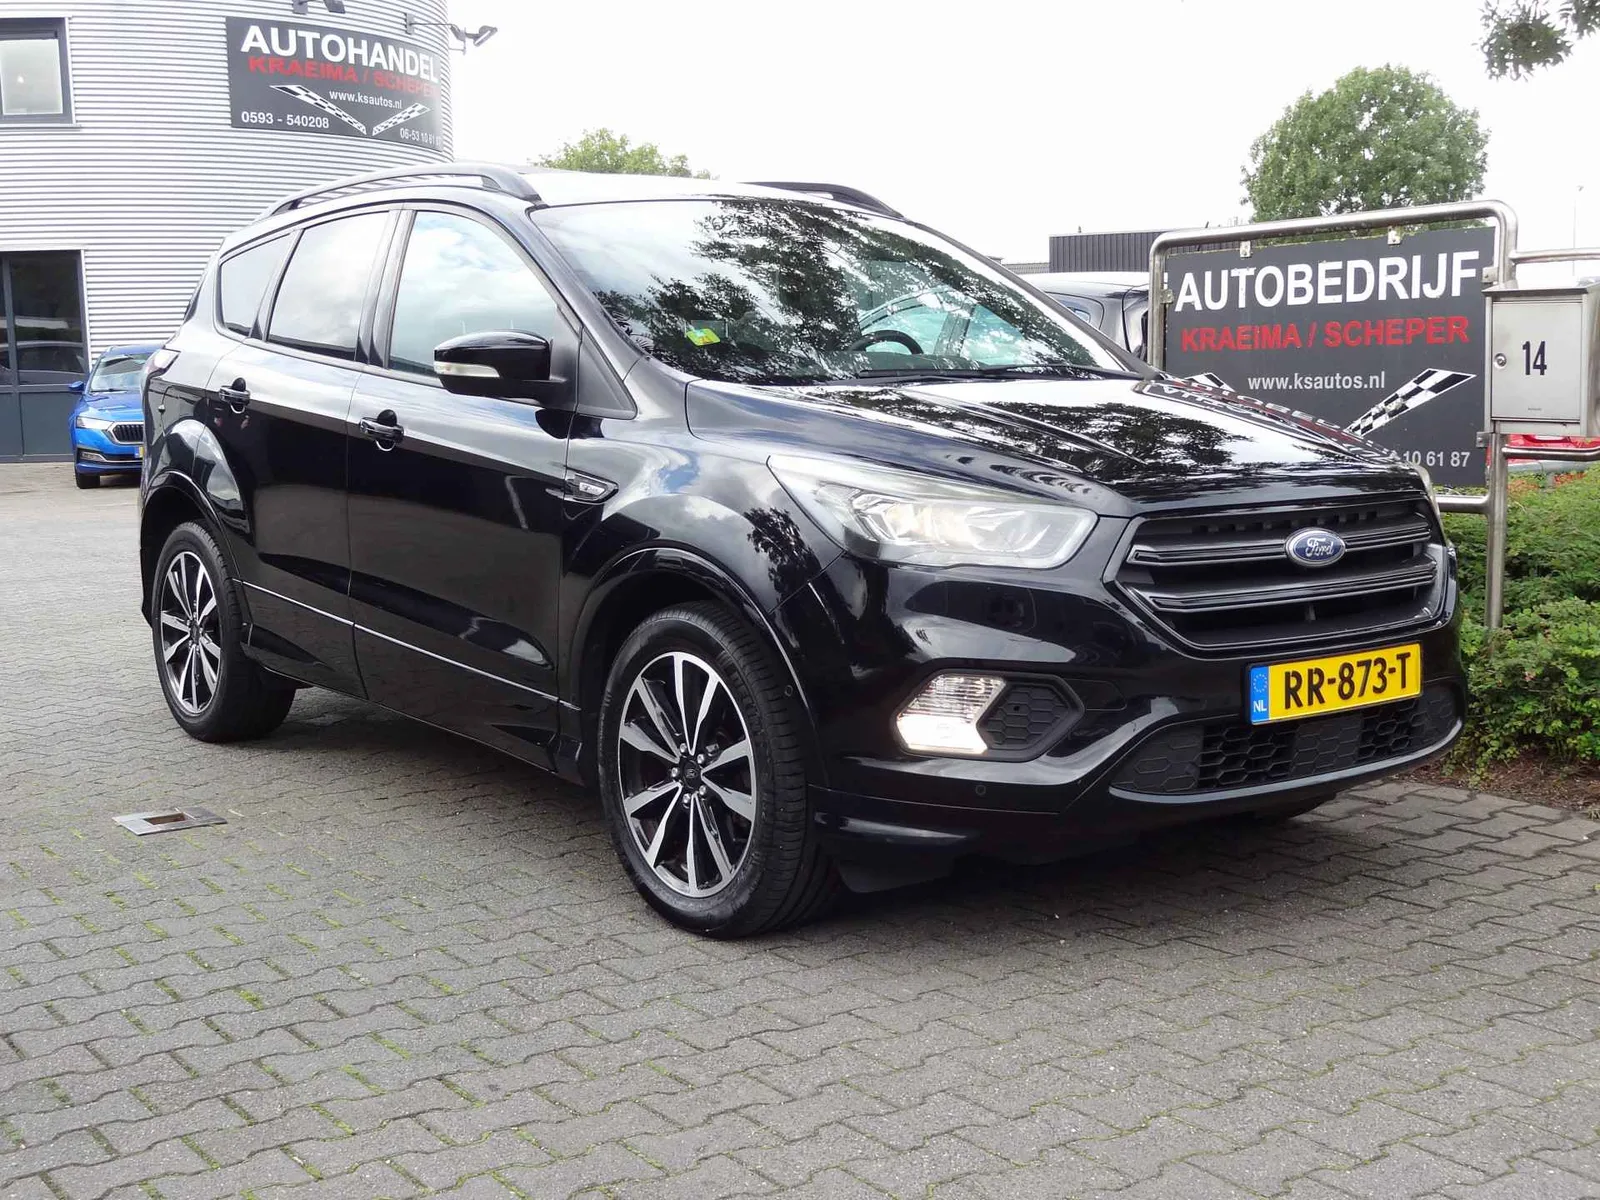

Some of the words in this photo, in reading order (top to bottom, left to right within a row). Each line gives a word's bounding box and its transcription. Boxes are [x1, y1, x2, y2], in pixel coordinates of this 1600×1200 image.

[240, 25, 439, 84] AUTOHANDEL
[247, 55, 359, 85] KRAEIMA
[362, 69, 370, 85] /
[329, 90, 403, 110] www.ksautos.nl
[241, 111, 274, 125] 0593
[286, 114, 330, 129] 540208
[1175, 250, 1480, 312] AUTOBEDRIJF
[1181, 322, 1301, 353] KRAEIMA
[1307, 320, 1318, 348] /
[1324, 315, 1470, 348] SCHEPER
[1522, 340, 1548, 376] 14
[1248, 371, 1386, 391] www.ksautos.nl
[1403, 450, 1422, 466] 10
[1426, 451, 1444, 467] 61
[1450, 451, 1470, 467] 87
[1305, 537, 1334, 558] Ford
[1284, 652, 1411, 710] RR-873-T
[1253, 699, 1267, 713] NL
